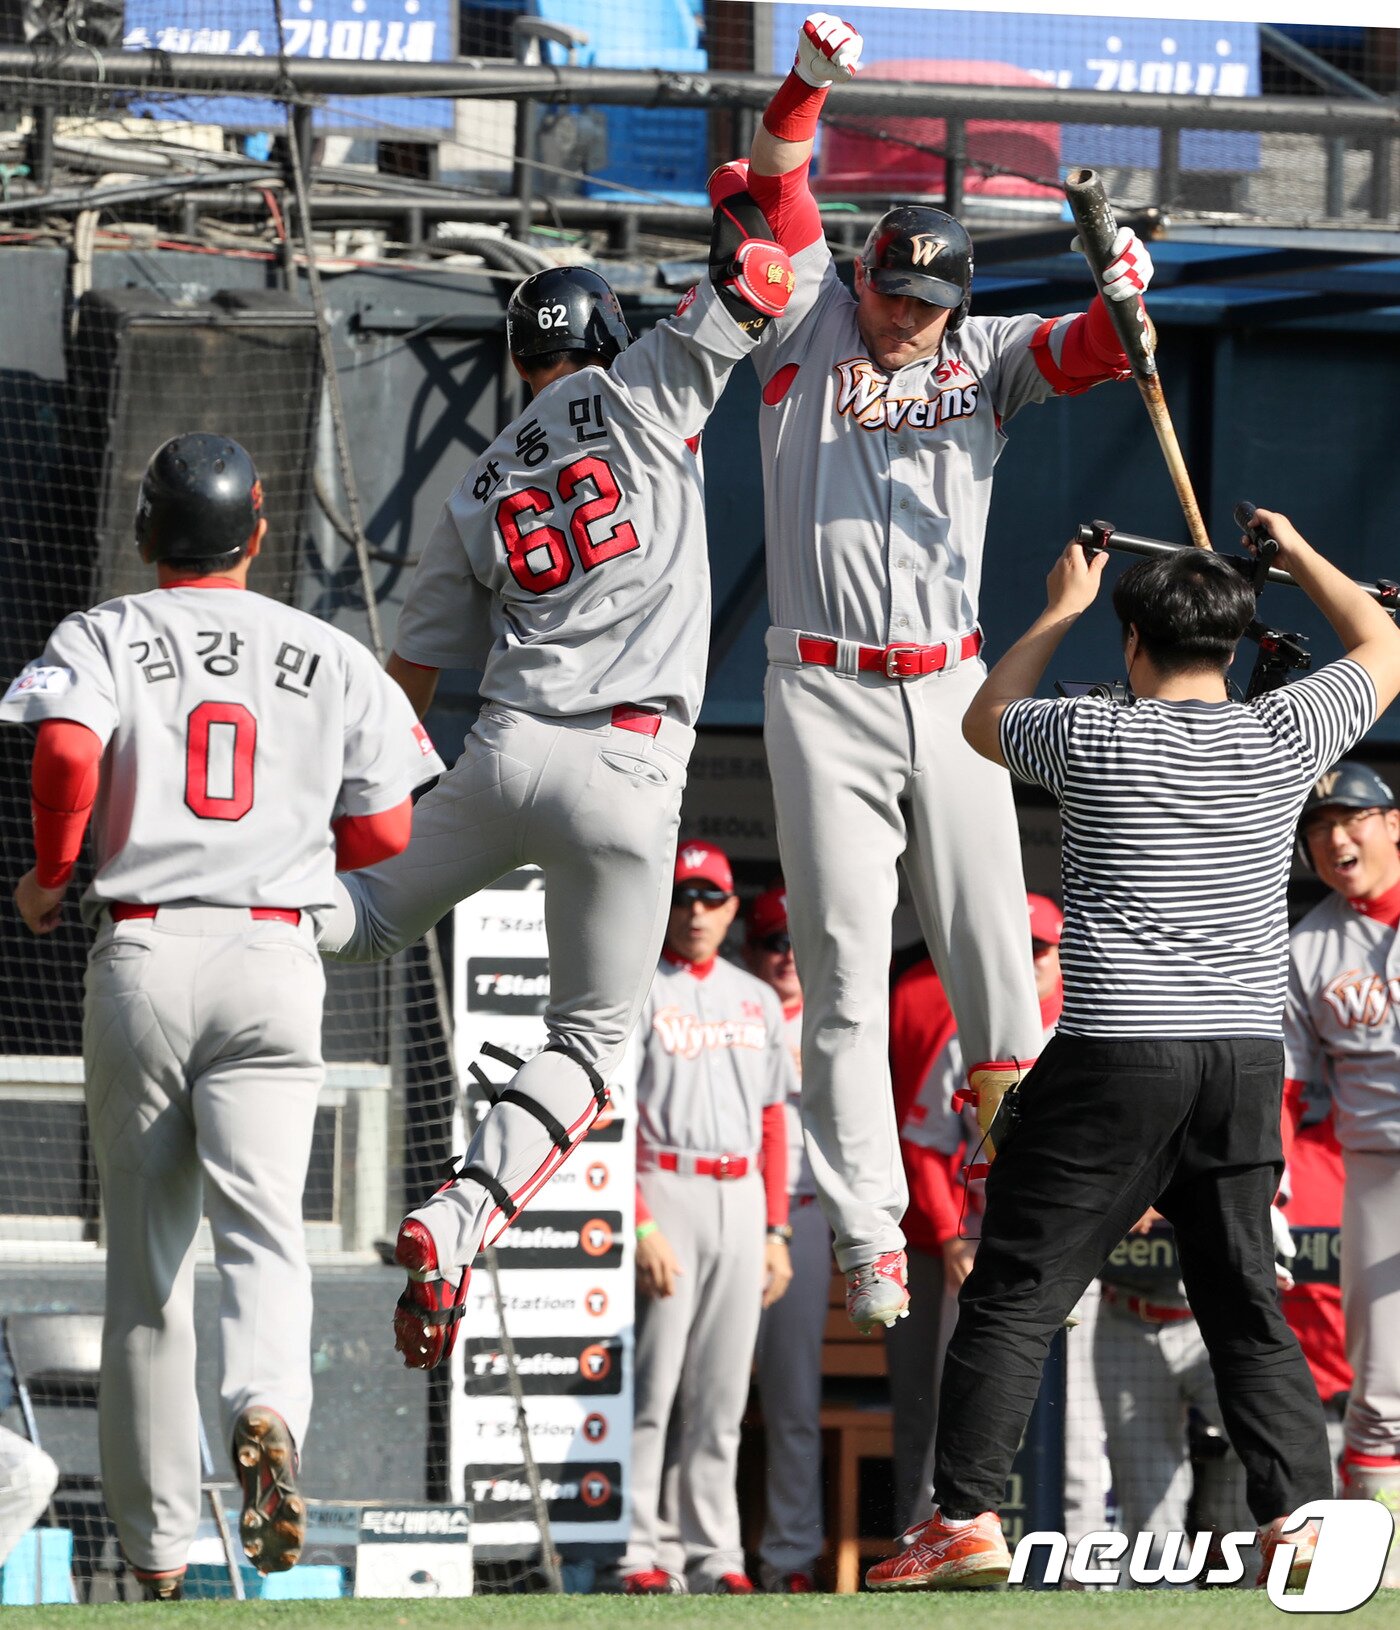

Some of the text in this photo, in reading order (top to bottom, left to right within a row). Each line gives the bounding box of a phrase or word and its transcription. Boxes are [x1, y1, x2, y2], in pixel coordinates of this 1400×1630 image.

[909, 233, 948, 267] W
[538, 304, 569, 330] 62
[834, 357, 980, 432] Wyverns
[934, 360, 972, 383] SK
[495, 455, 641, 596] 62
[128, 630, 322, 699] 김강민
[184, 700, 257, 822] 0
